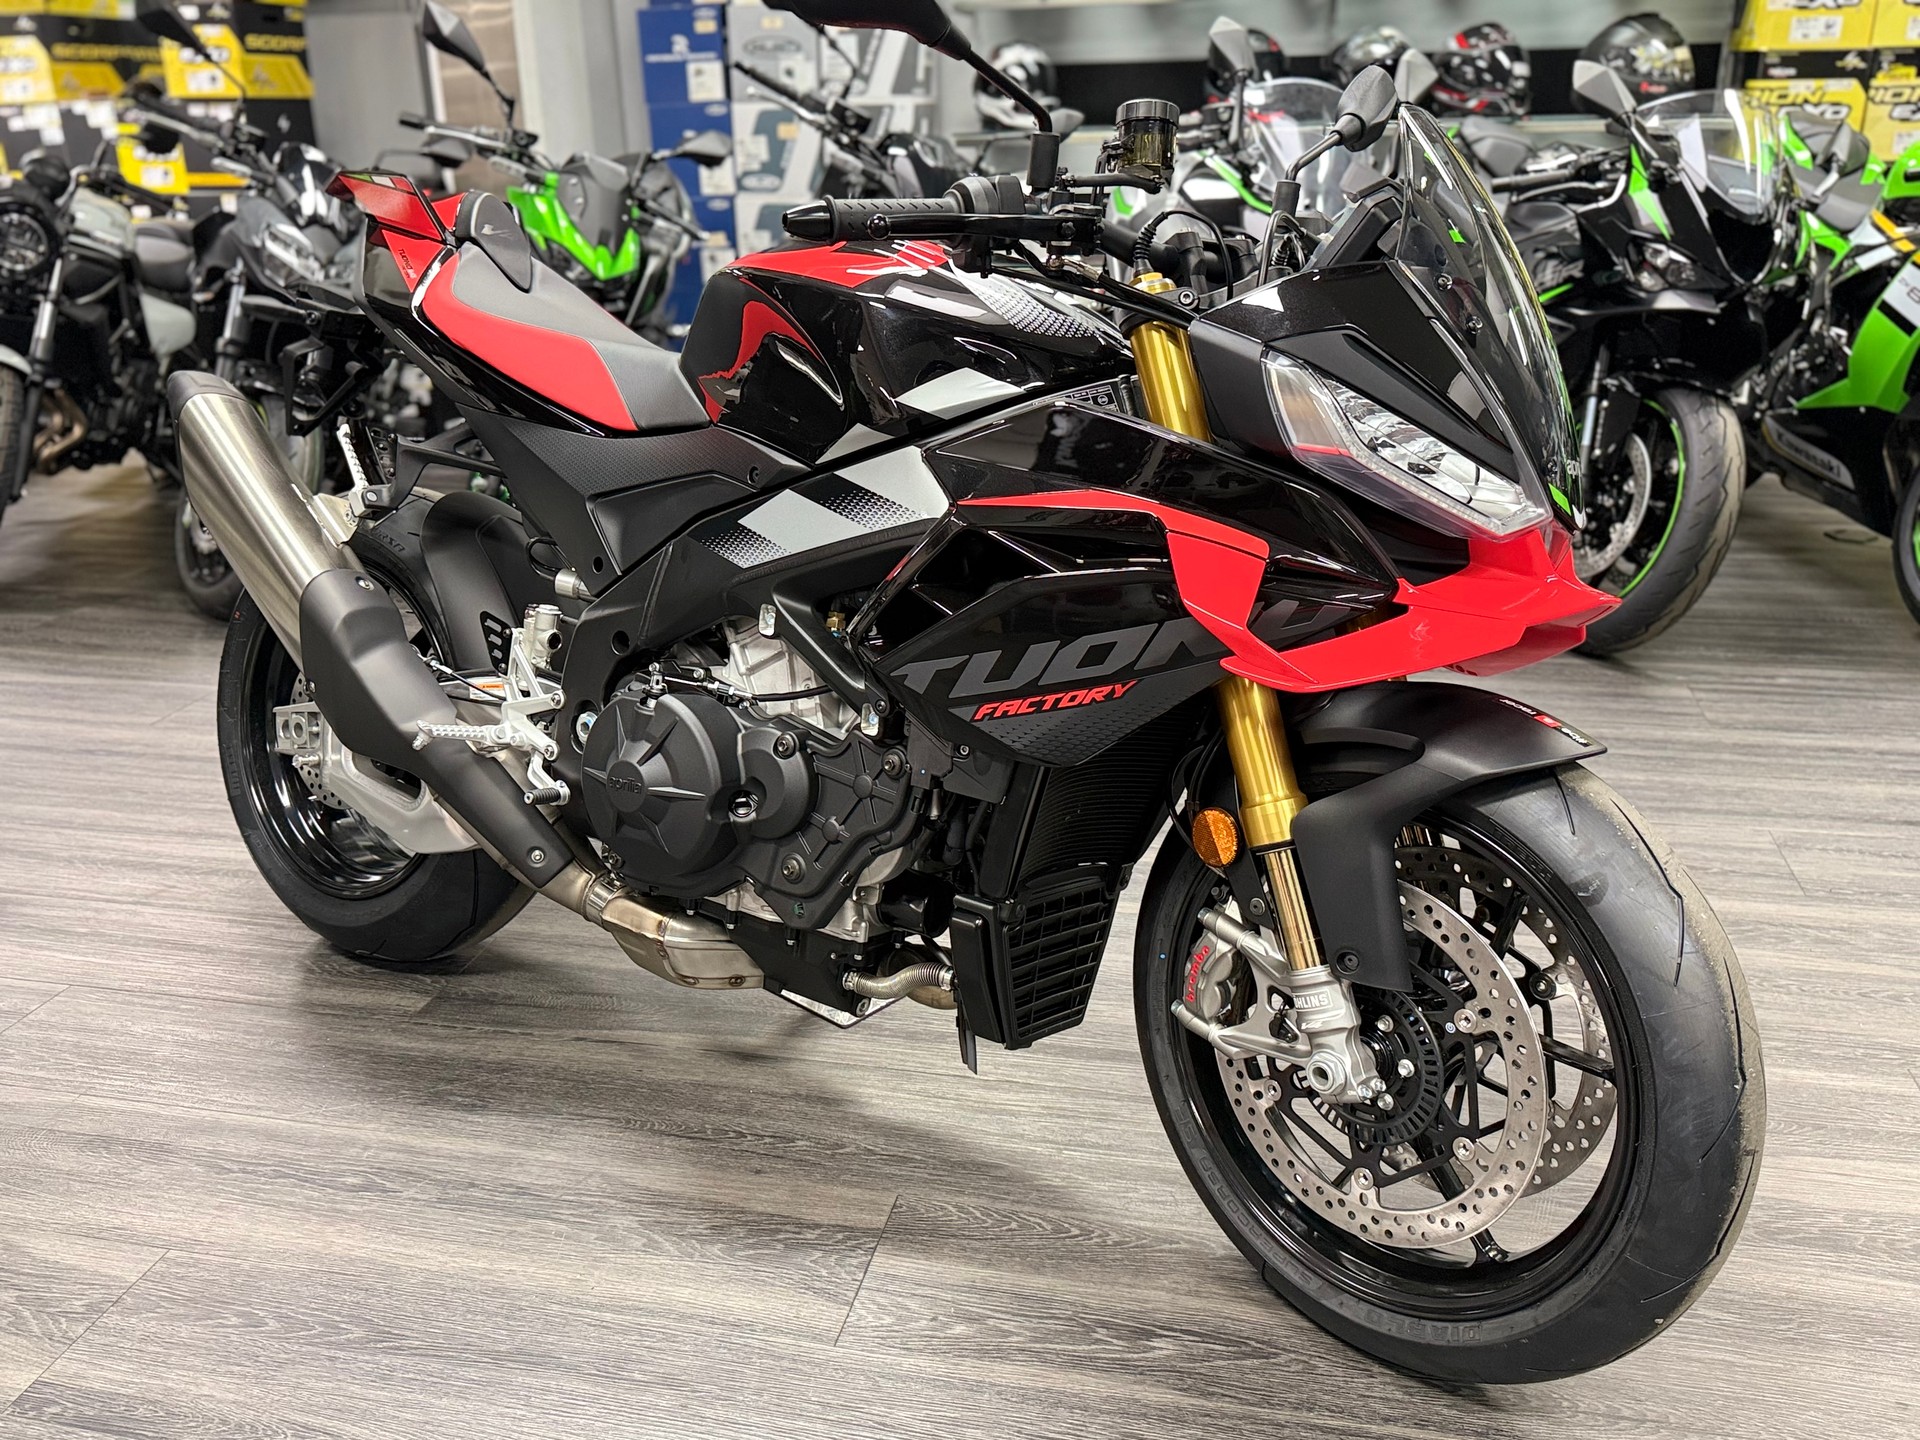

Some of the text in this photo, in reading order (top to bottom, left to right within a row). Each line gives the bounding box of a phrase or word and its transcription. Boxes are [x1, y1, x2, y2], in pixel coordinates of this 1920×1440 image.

[971, 680, 1139, 723] FACTORY
[609, 776, 642, 795] aprilia
[1185, 944, 1211, 1003] brembo
[1196, 1154, 1315, 1288] SUPERCORSA
[1362, 1307, 1484, 1344] DIABLO
